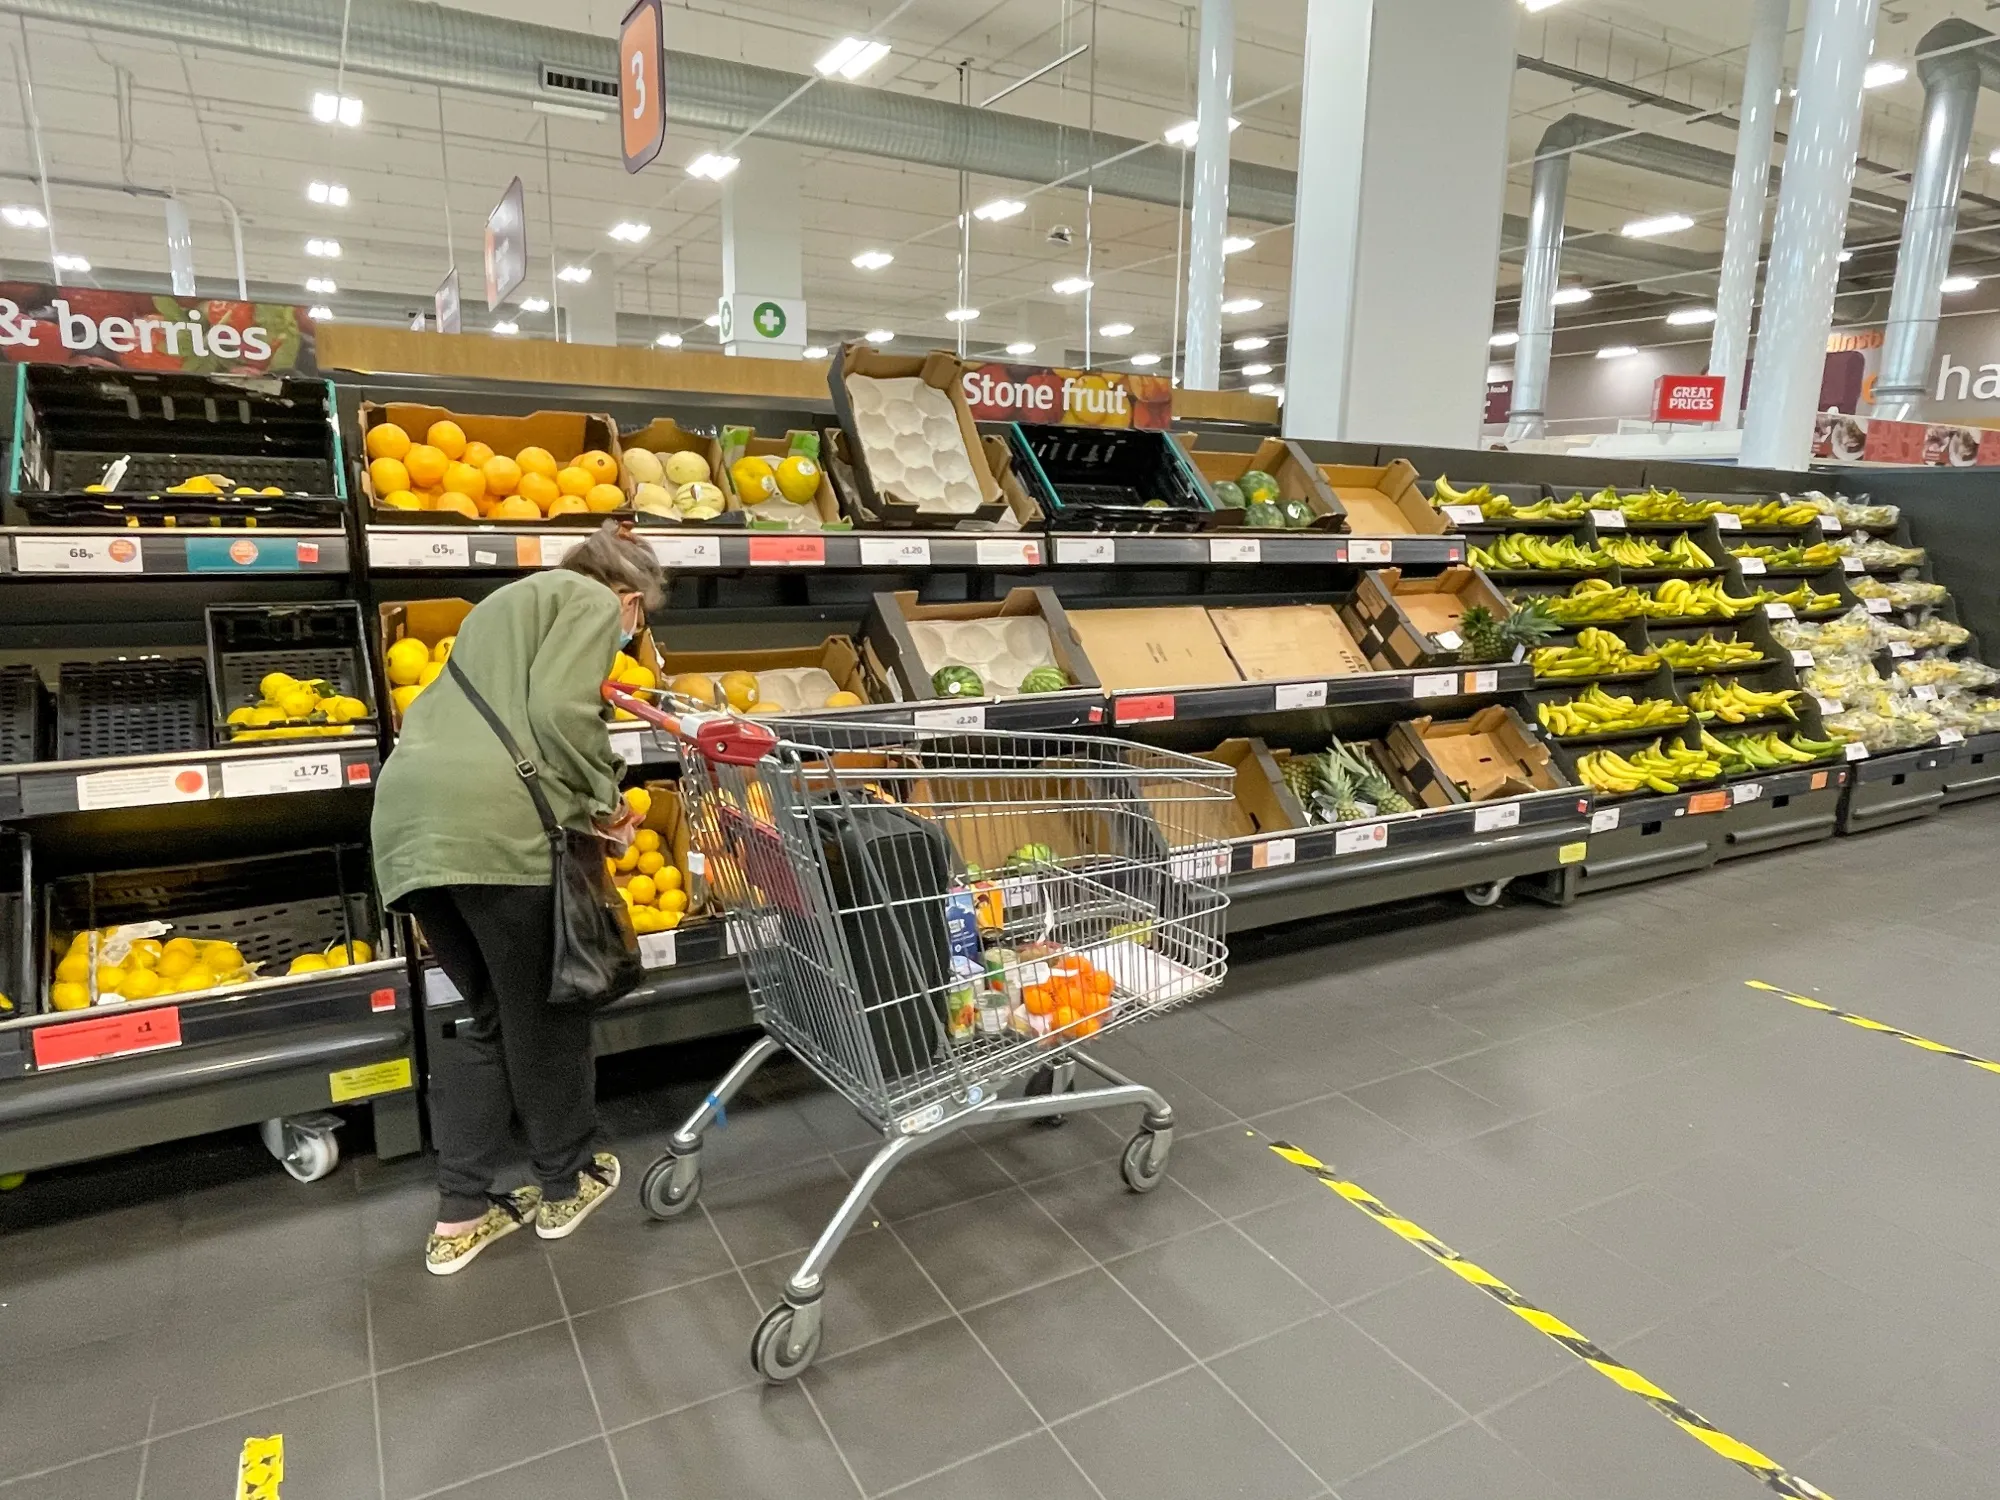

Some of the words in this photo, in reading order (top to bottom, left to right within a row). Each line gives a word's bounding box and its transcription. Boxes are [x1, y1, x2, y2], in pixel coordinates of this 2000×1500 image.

[632, 50, 646, 119] 3
[0, 298, 40, 346] &
[51, 299, 272, 361] berries
[1935, 354, 2000, 401] ha
[962, 371, 1054, 410] Stone
[1061, 377, 1128, 415] fruit
[1672, 387, 1714, 399] GREAT
[1668, 399, 1714, 410] PRICES
[69, 548, 94, 560] 68p
[432, 544, 455, 556] 65p
[294, 764, 329, 778] £1.75
